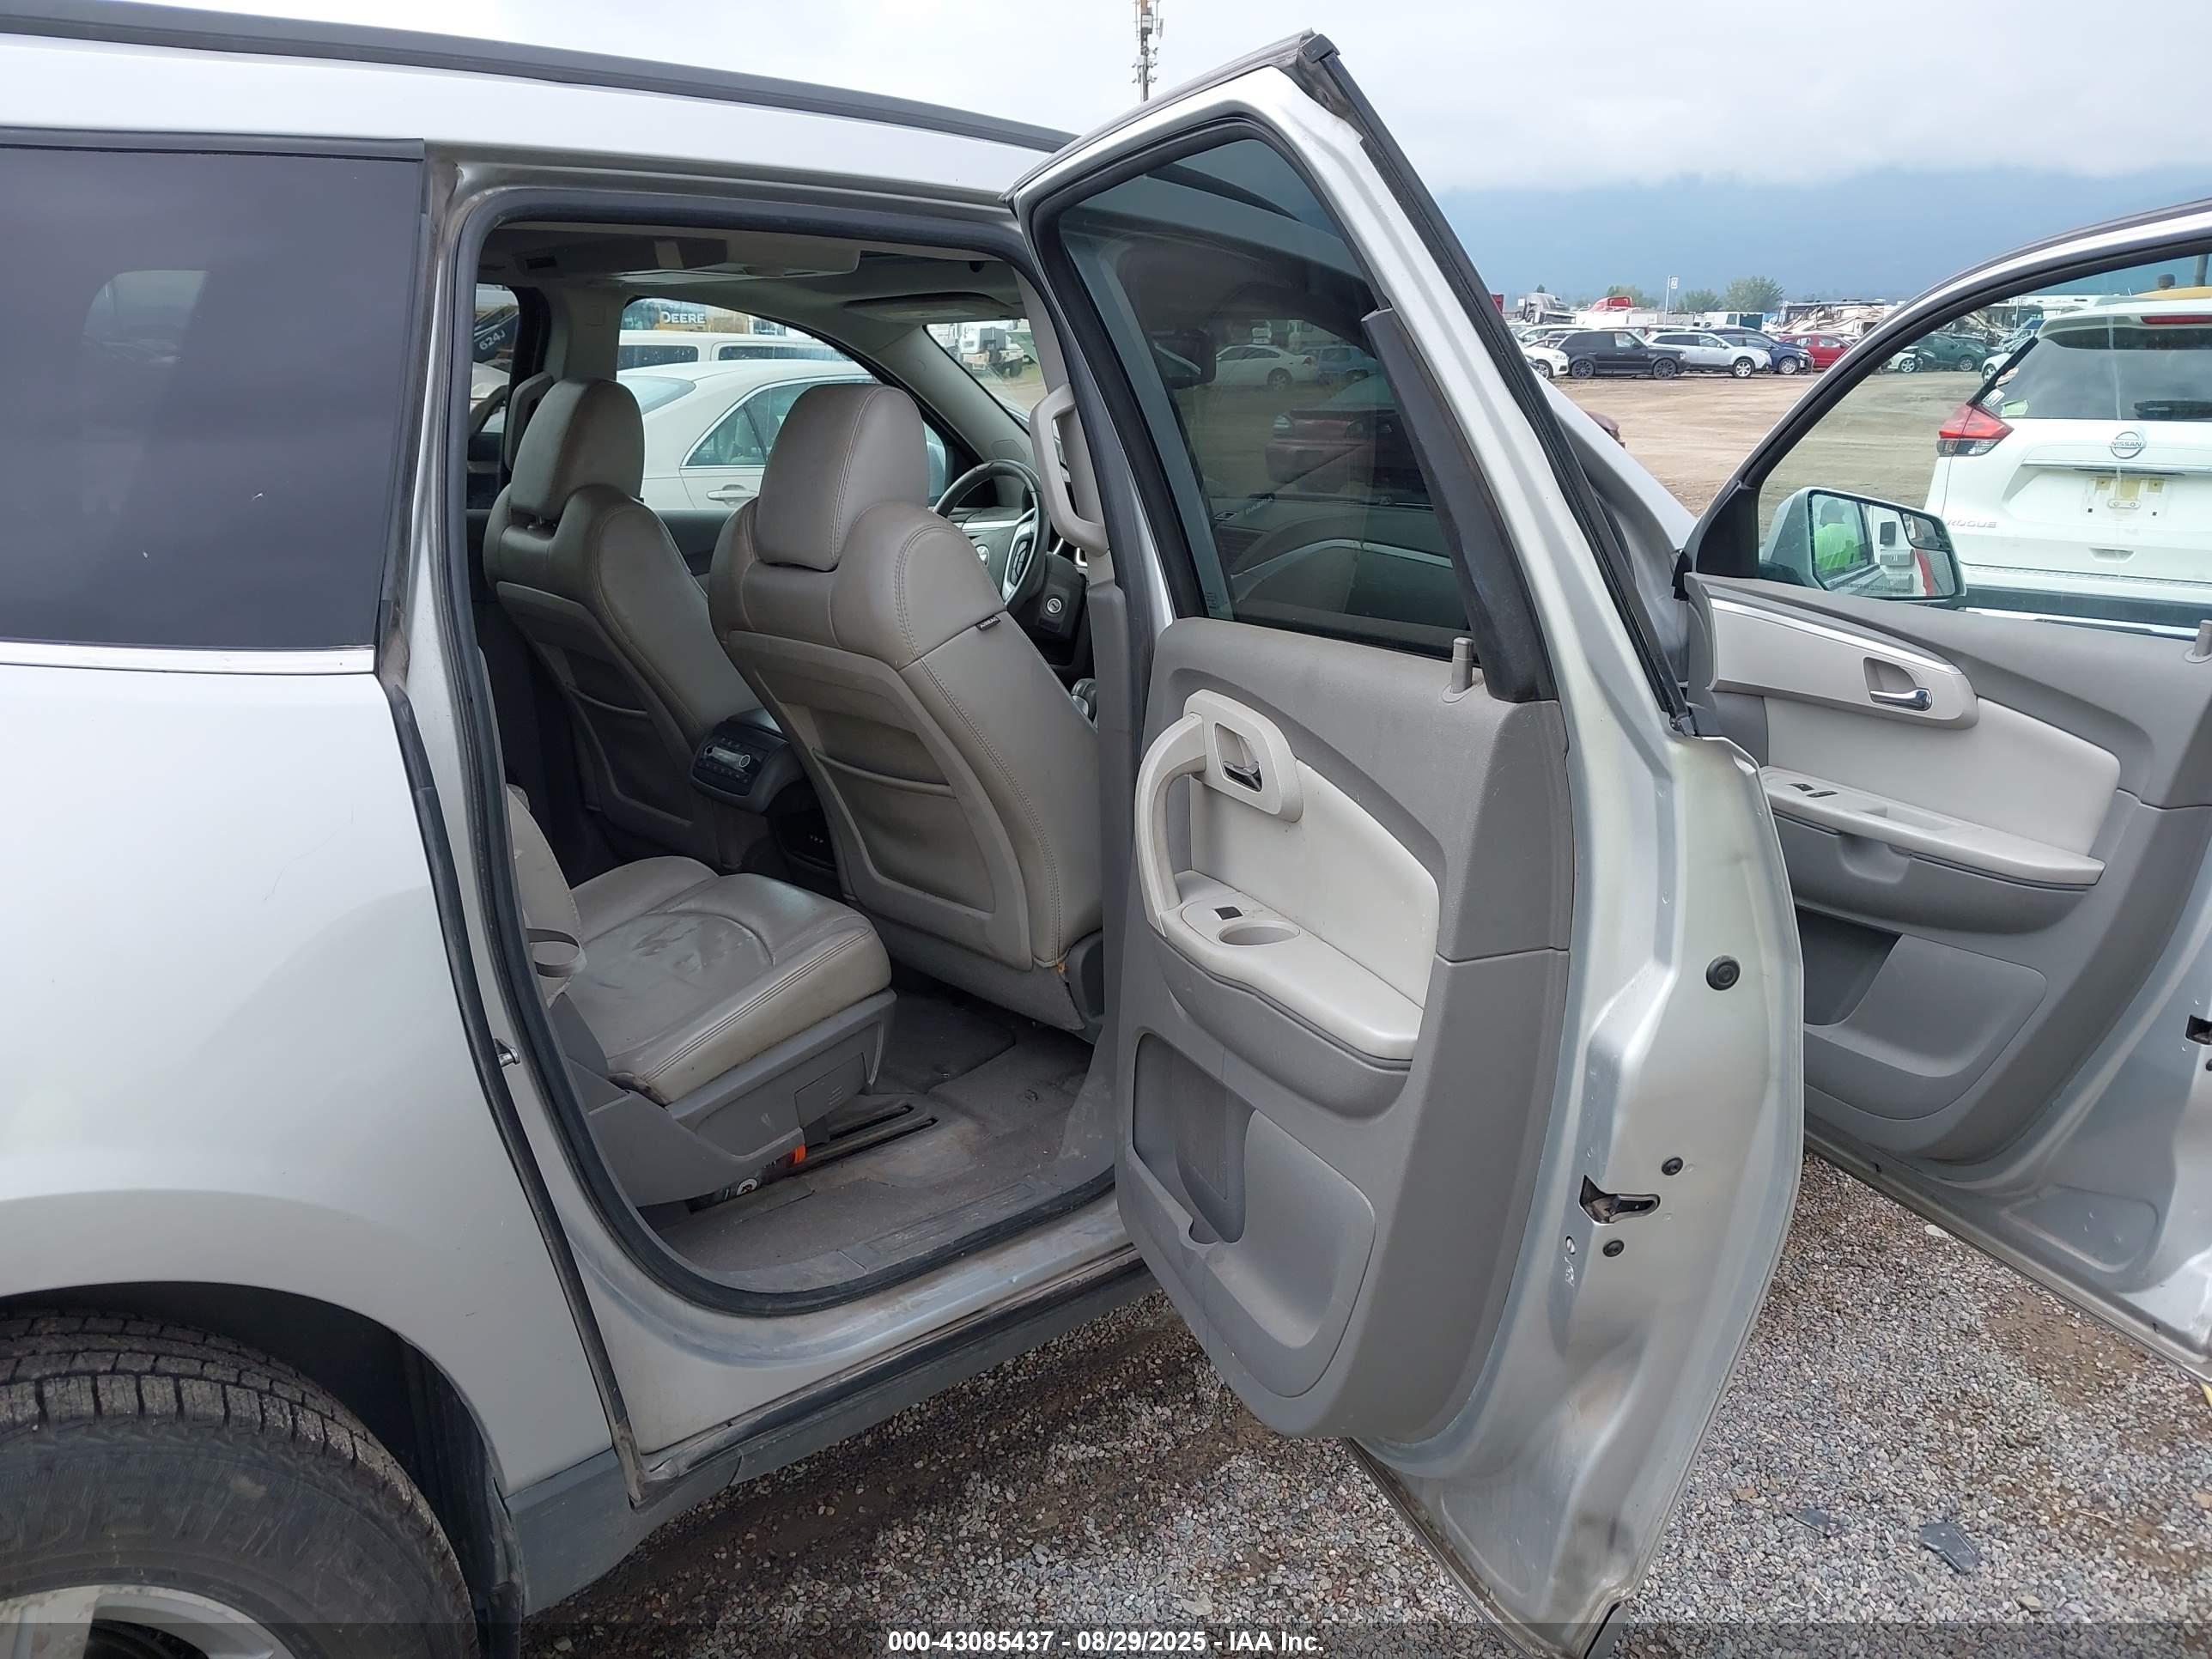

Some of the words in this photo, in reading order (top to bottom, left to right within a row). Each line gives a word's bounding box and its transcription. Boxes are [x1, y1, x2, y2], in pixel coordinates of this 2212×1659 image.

[659, 311, 706, 324] DEERE
[479, 330, 506, 350] 624J
[1947, 519, 1997, 529] ROGUE
